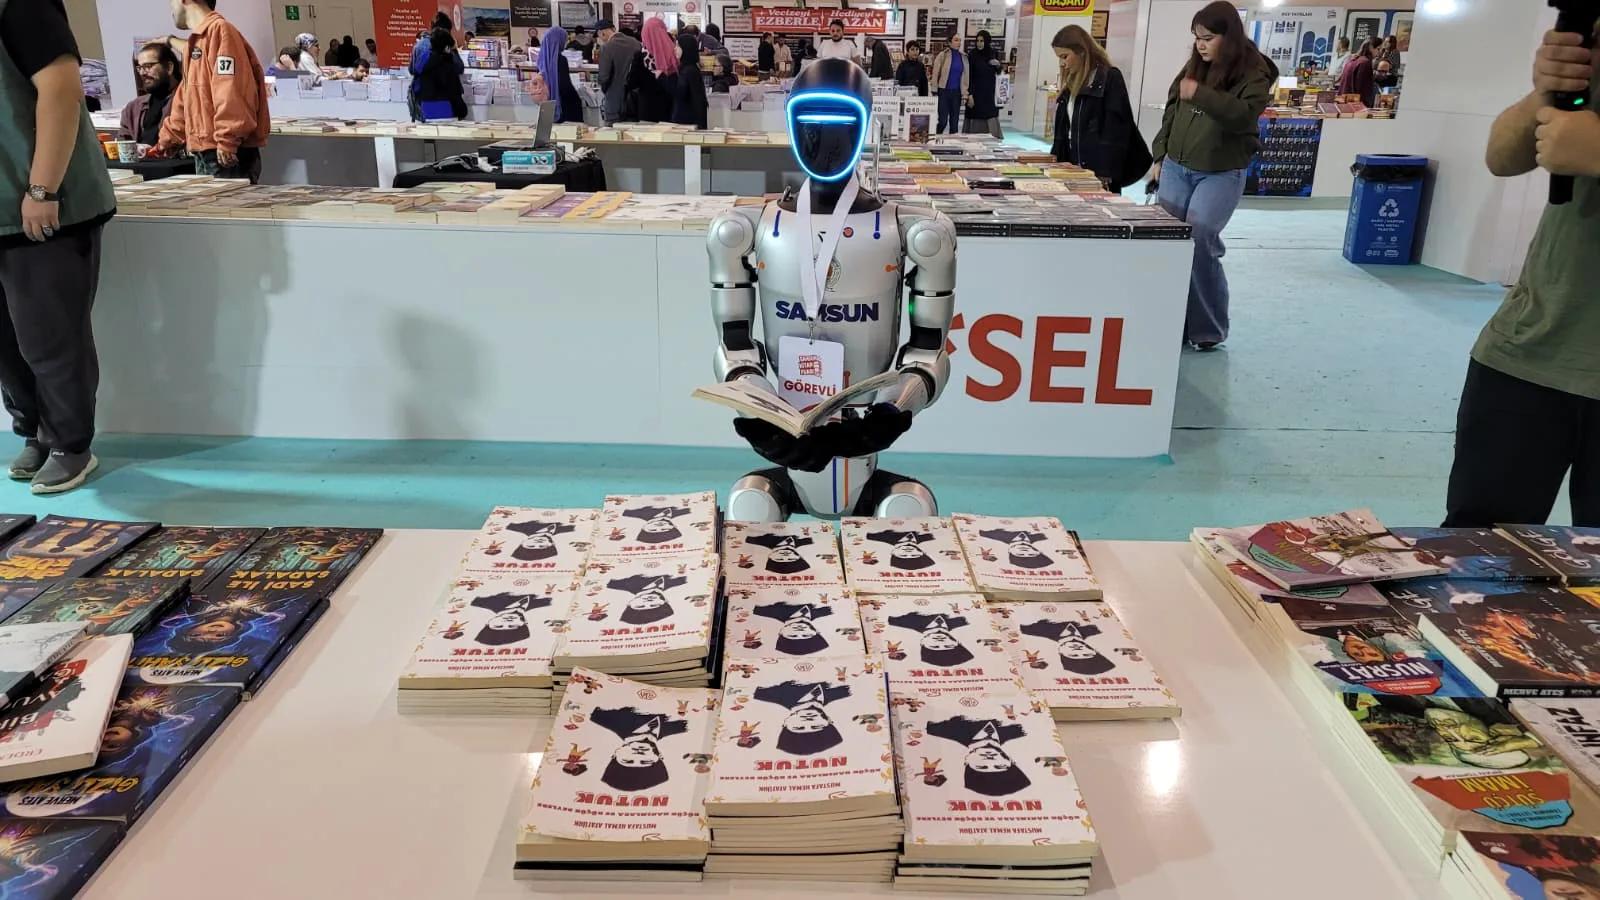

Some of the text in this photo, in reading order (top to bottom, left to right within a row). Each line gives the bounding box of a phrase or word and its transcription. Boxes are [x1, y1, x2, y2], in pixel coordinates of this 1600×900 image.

[768, 9, 811, 17] Vecizeyi
[830, 9, 874, 18] Hediyeyi
[756, 17, 822, 26] EZBERLE
[220, 60, 231, 70] 37
[945, 313, 1153, 406] SEL
[784, 379, 837, 397] GÖREVLİ
[103, 569, 205, 578] SADALAK
[229, 570, 330, 579] SADALAK
[599, 624, 674, 636] NUTUK
[452, 648, 527, 656] NUTUK
[908, 668, 984, 677] NUTUK
[1340, 661, 1434, 680] NUSRAT
[753, 757, 847, 770] NUTUK
[1456, 775, 1533, 793] İMAM
[574, 791, 669, 807] NUTUK
[1482, 792, 1545, 811] SÜTÇÜ
[947, 800, 1042, 811] NUTUK
